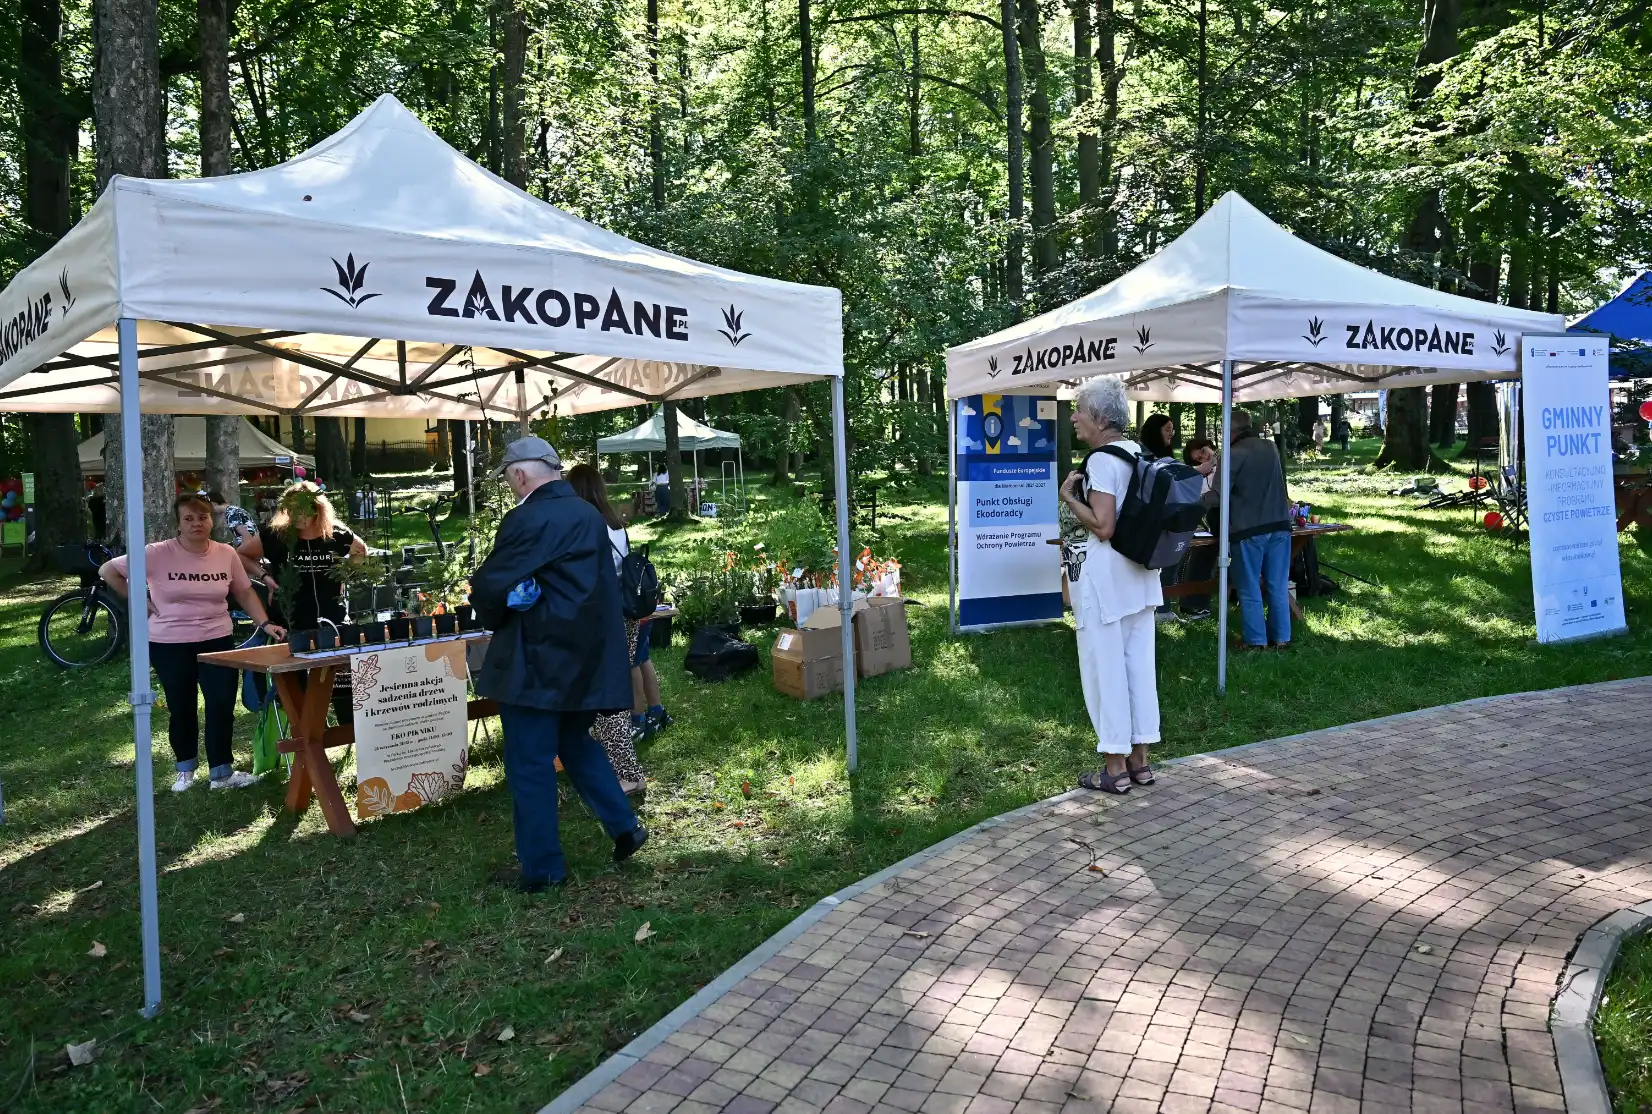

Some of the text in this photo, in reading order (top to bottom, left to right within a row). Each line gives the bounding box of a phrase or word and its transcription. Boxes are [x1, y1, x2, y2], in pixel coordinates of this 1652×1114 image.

[425, 268, 689, 342] ZAKOPANE
[0, 292, 51, 366] AKOPANE
[1346, 319, 1475, 355] ZAKOPANE
[1012, 336, 1117, 375] ZAKOPANE
[1542, 406, 1603, 430] GMINNY
[1547, 433, 1602, 457] PUNKT
[1017, 468, 1046, 476] Europejskie
[976, 497, 1033, 507] Punkt Obsługi
[976, 509, 1024, 518] Ekodoradcy
[1543, 505, 1611, 523] CZYSTE POWIETRZE
[976, 531, 1042, 541] Wdrażanie Programu
[1004, 540, 1036, 548] Powietrza
[168, 572, 228, 582] L'AMOUR
[379, 676, 443, 693] Jesienna akcja
[377, 686, 445, 704] sadzenia drzew
[365, 694, 458, 717] i krzewów rodzimych
